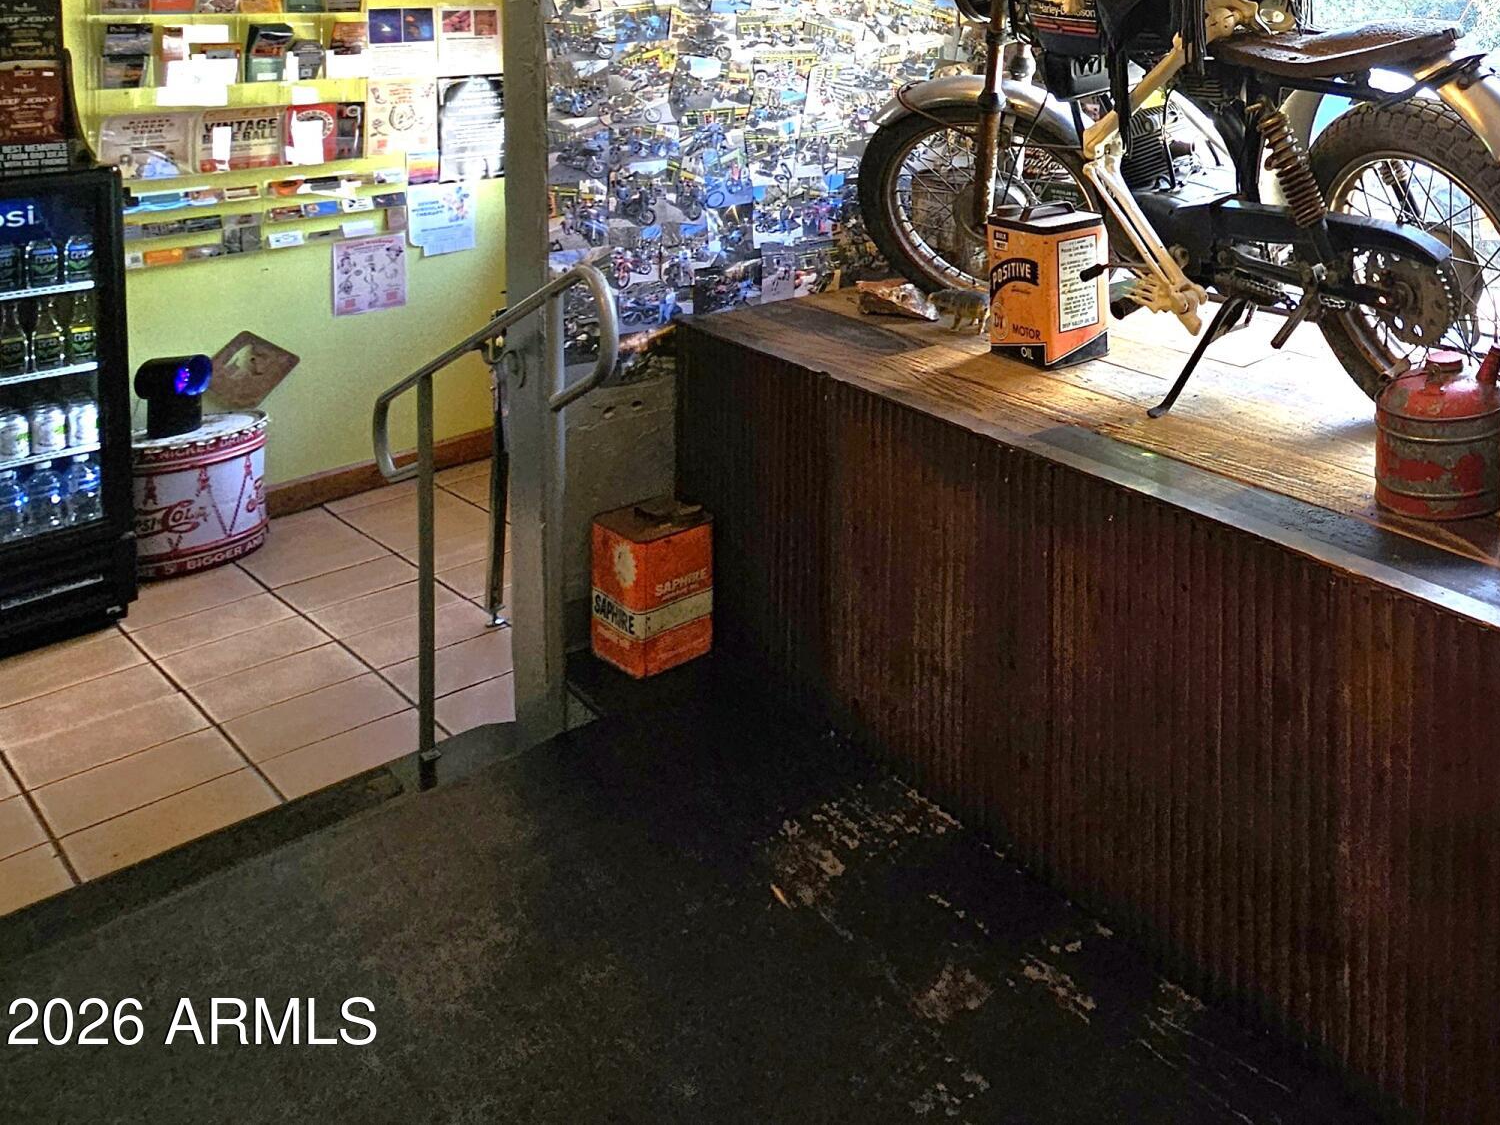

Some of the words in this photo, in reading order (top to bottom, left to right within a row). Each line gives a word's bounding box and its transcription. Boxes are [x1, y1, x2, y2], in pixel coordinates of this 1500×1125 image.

[1040, 2, 1096, 18] Harley-Ddson
[203, 118, 278, 133] VINTAGE
[202, 132, 242, 145] BE
[242, 130, 278, 141] BALL
[992, 262, 1032, 291] POSITIVE
[1012, 323, 1041, 341] MOTOR
[1020, 346, 1034, 360] OIL
[185, 544, 243, 570] BIGGER
[593, 593, 636, 636] SAPHIRE
